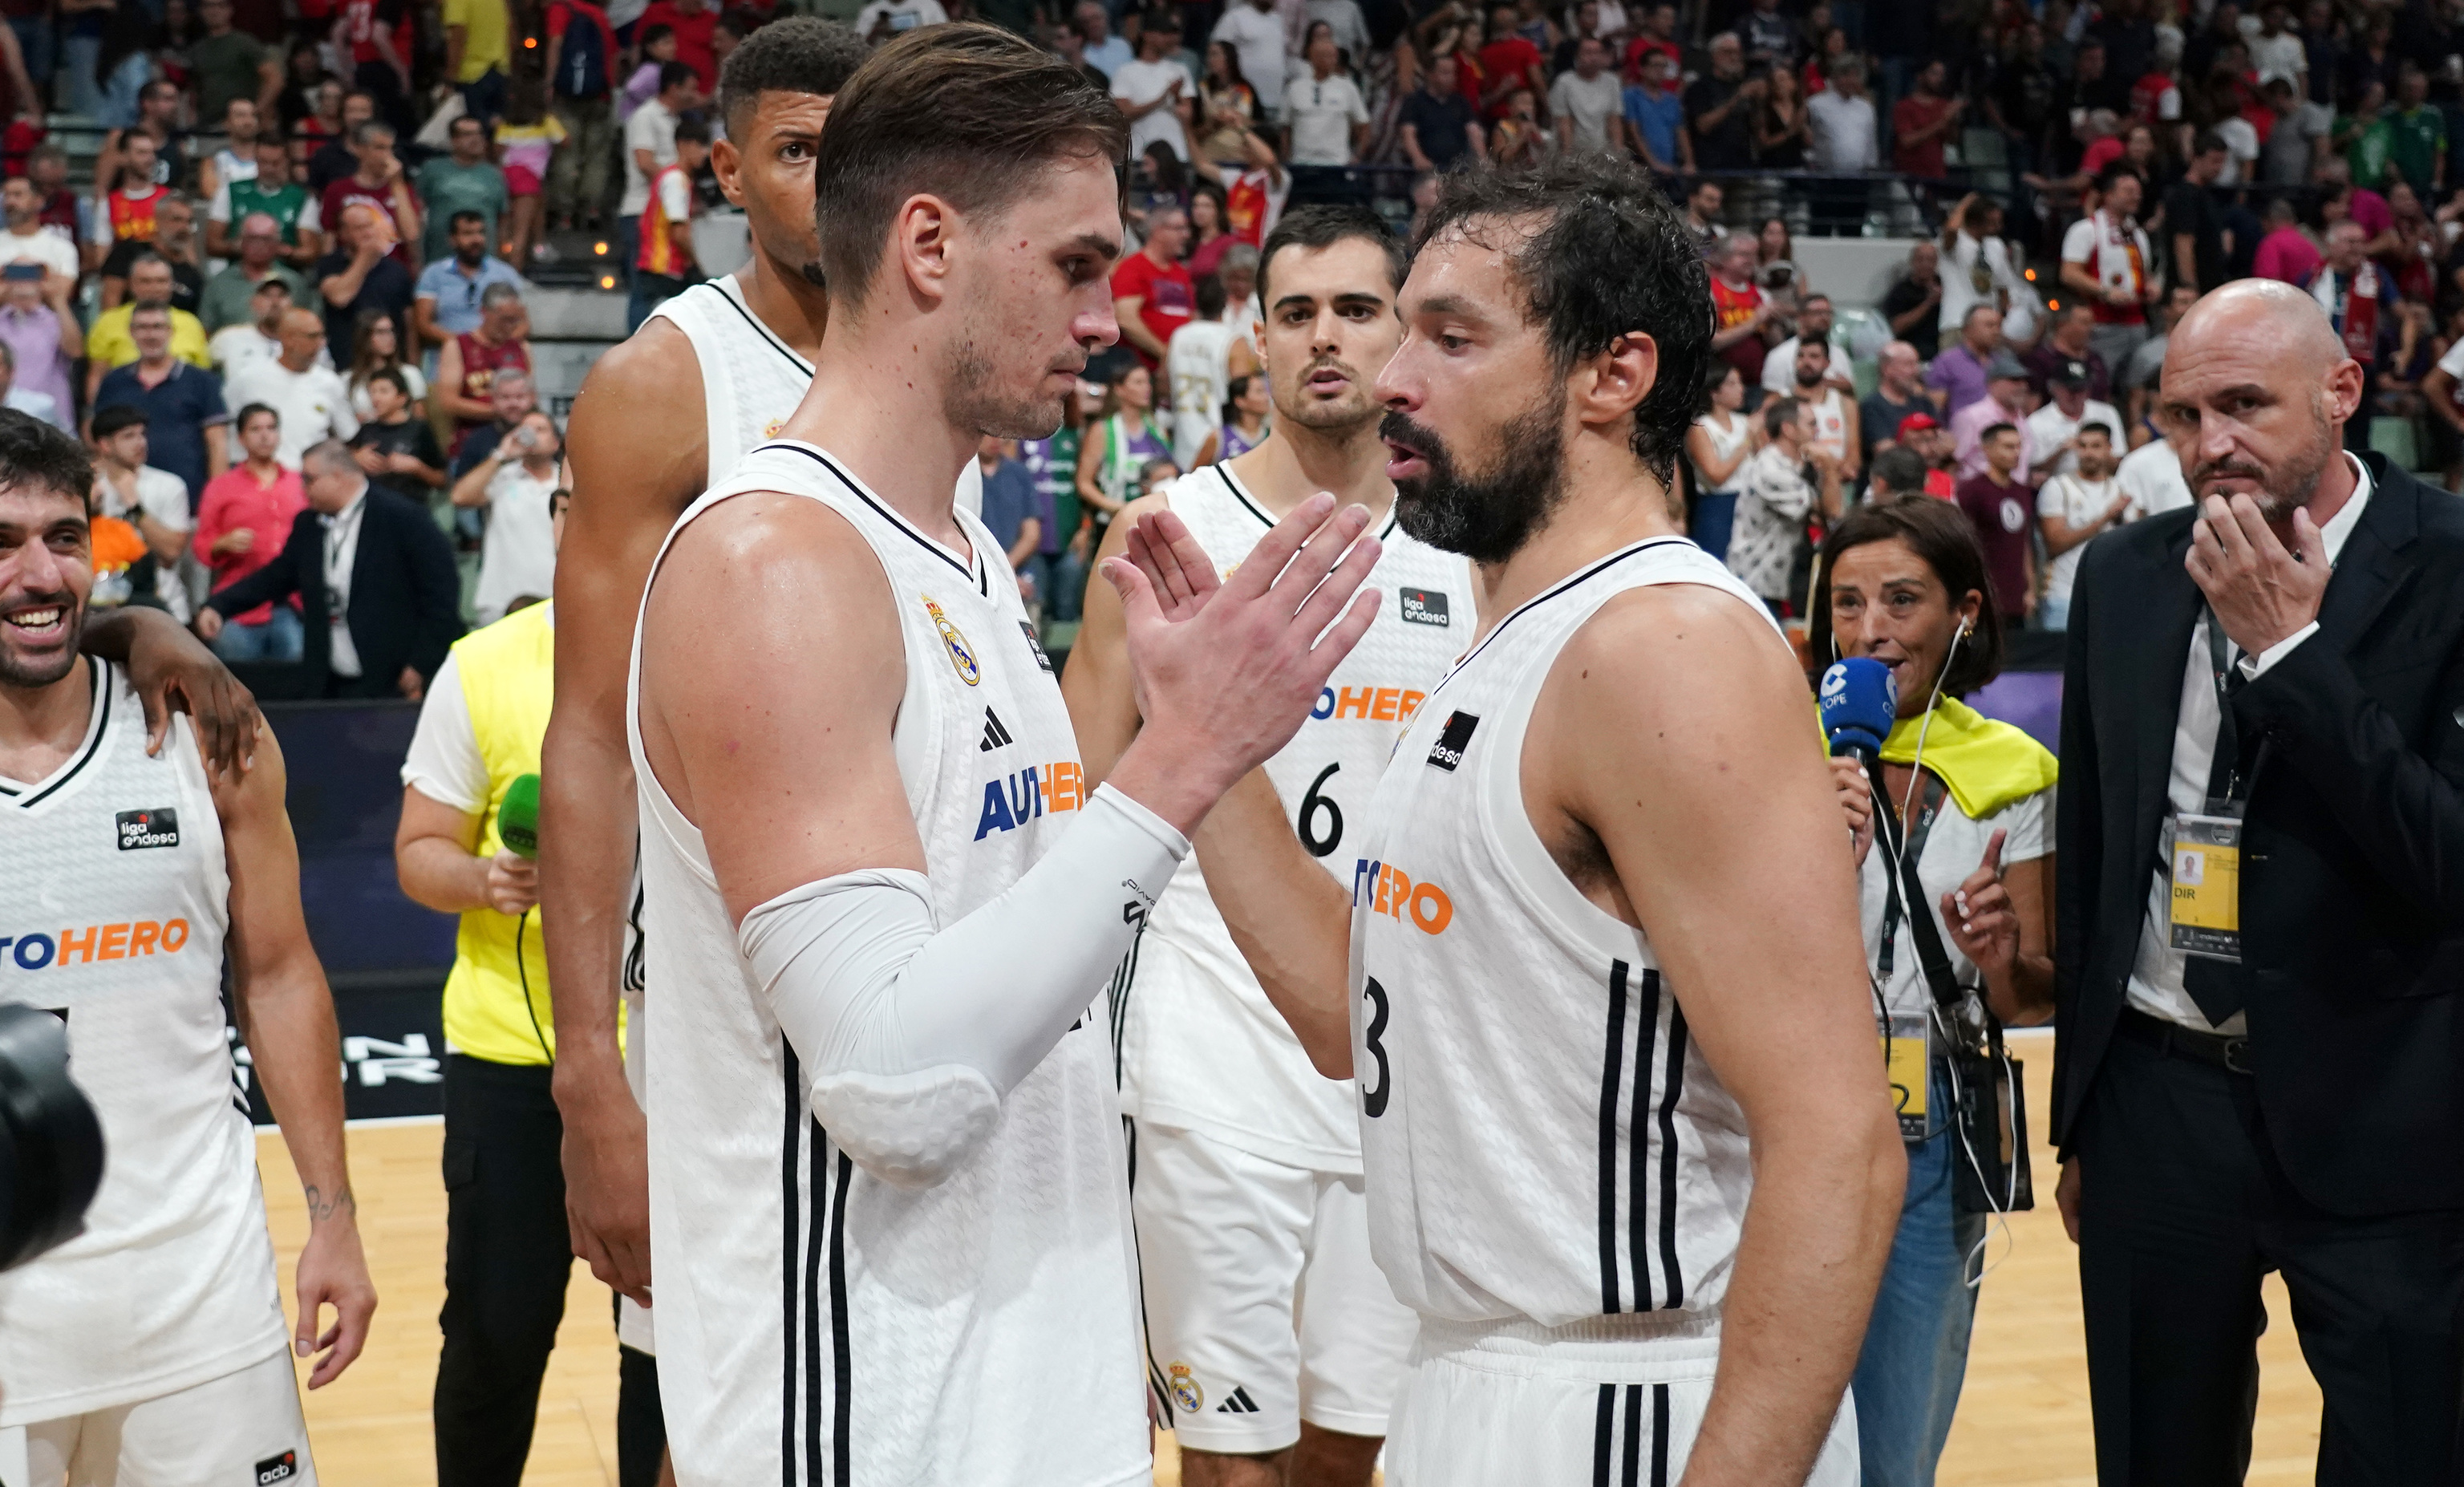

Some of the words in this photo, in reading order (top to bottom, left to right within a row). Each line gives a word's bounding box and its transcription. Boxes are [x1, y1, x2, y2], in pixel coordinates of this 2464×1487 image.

[1404, 597, 1424, 611] liga
[1404, 610, 1448, 624] endesa
[1298, 761, 1343, 857] 6
[120, 821, 148, 836] liga
[123, 833, 177, 848] endesa
[2174, 887, 2195, 900] DIR
[1363, 975, 1390, 1118] 3
[260, 1464, 290, 1484] acb
